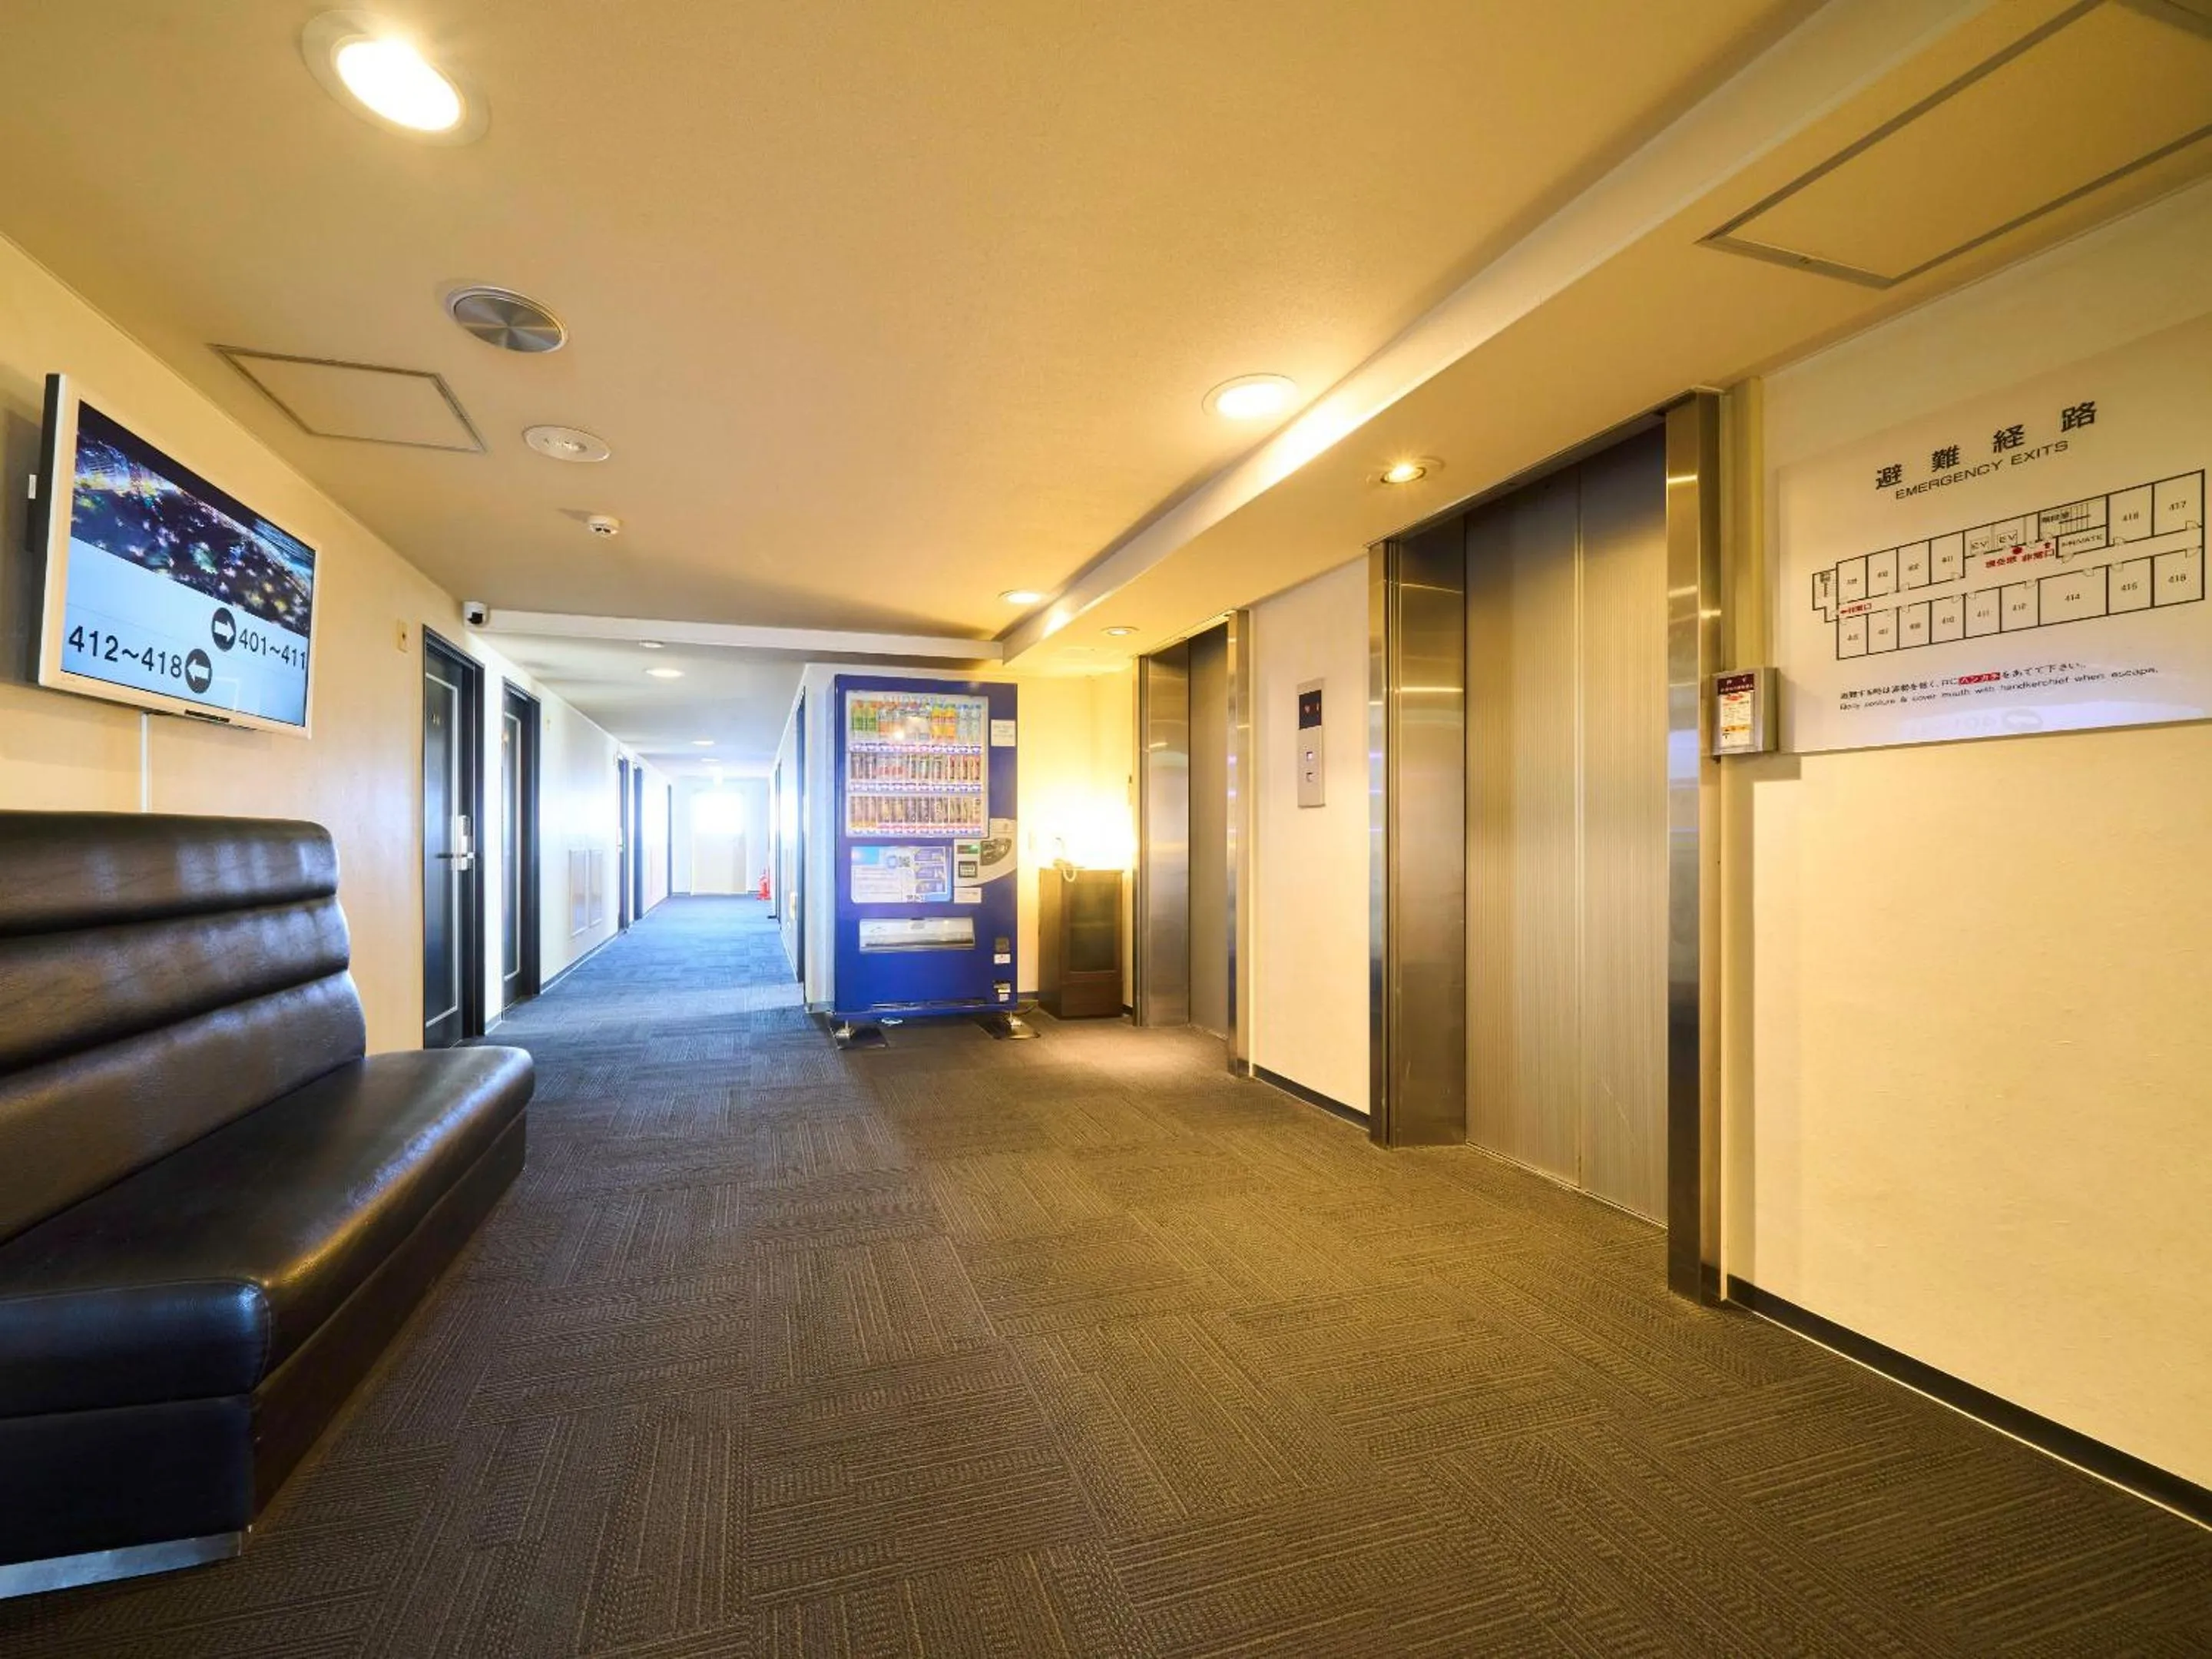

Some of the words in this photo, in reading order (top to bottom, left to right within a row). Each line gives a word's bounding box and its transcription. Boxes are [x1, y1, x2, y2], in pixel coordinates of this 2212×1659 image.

[1876, 401, 2097, 490] 避難経路
[1895, 459, 2003, 500] EMERGENCY
[2010, 440, 2069, 465] EXITS
[2065, 593, 2081, 601] 414
[2000, 677, 2069, 690] handkerchief
[2074, 673, 2105, 682] when
